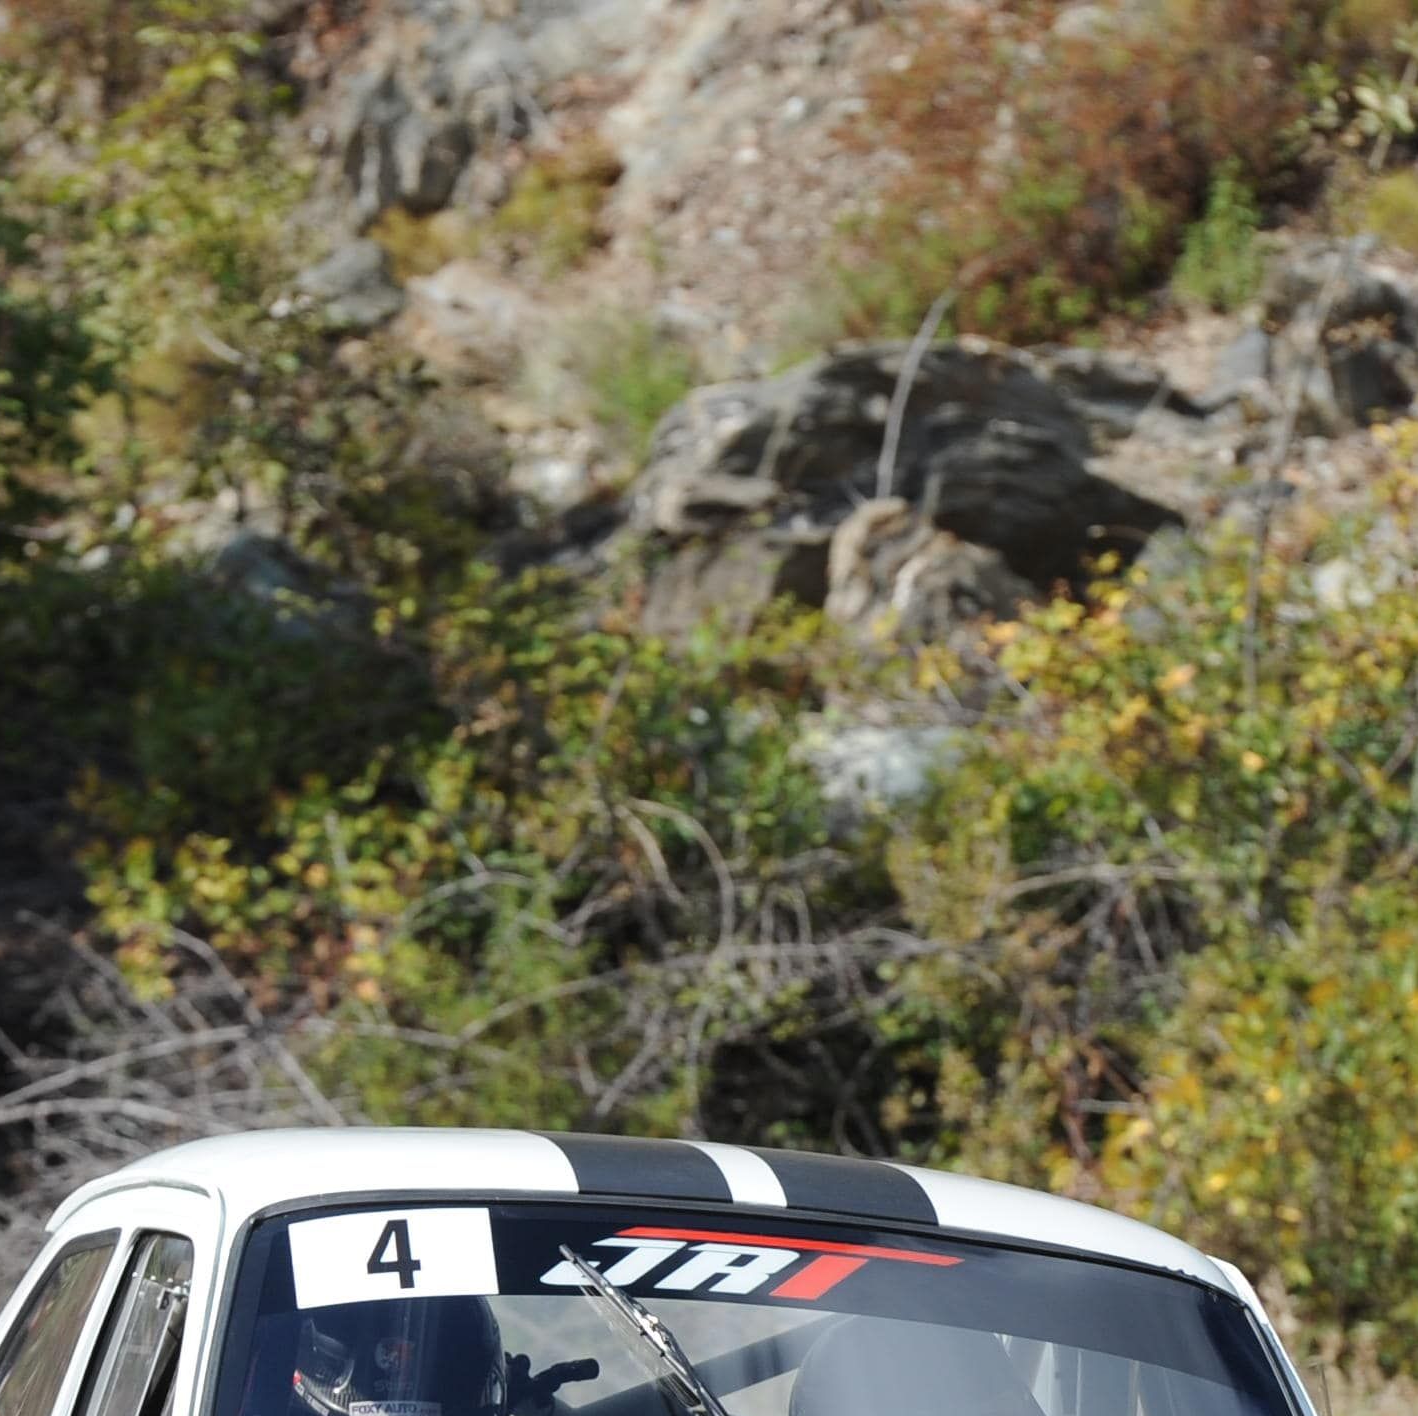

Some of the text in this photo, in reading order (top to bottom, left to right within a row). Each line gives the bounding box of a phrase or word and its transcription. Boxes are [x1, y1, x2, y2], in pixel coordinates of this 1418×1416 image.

[367, 1219, 421, 1289] 4
[352, 1403, 382, 1415] FOXY
[384, 1403, 418, 1415] AUTO
